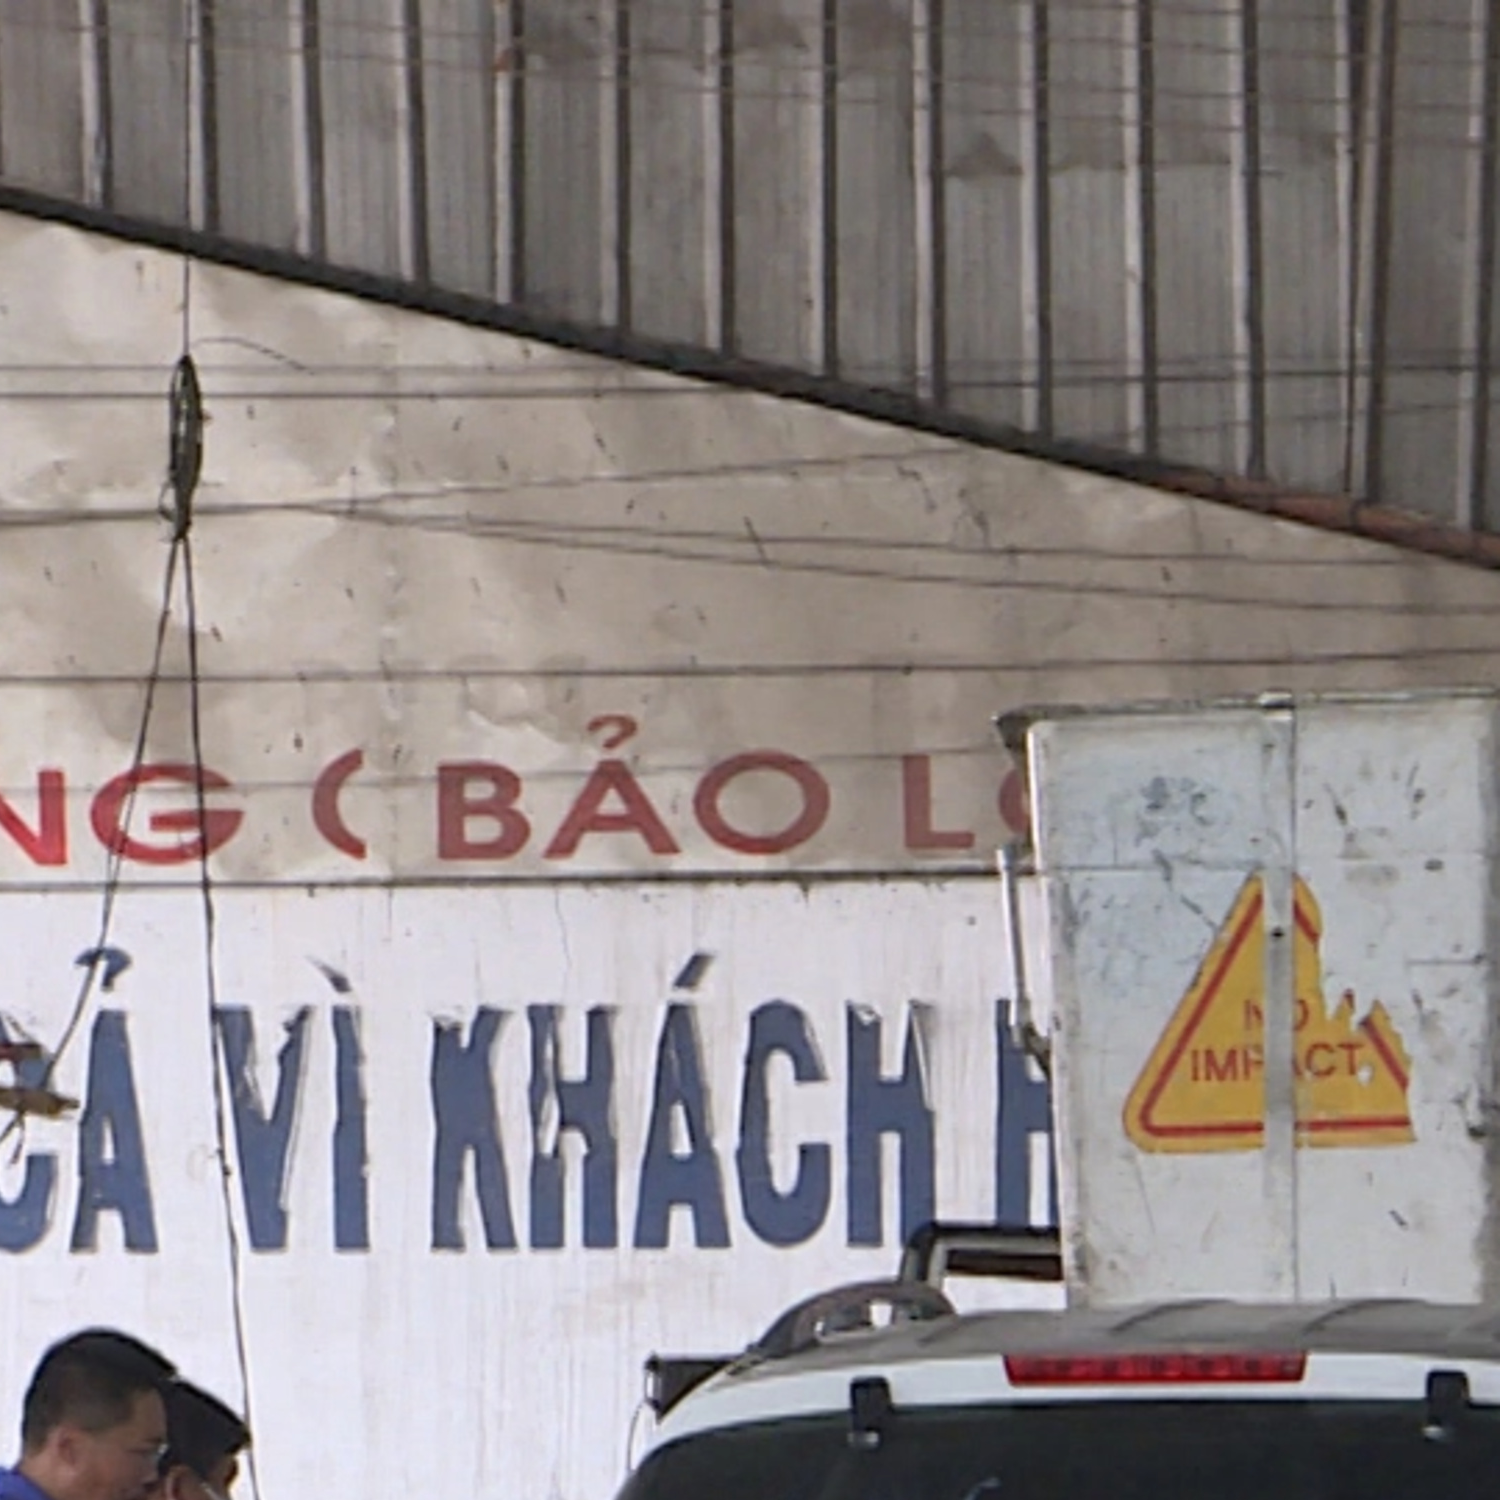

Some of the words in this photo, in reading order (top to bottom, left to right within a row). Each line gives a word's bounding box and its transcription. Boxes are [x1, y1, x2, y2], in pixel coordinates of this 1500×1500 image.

[436, 715, 831, 862] BẢO
[214, 957, 371, 1251] VÌ
[430, 952, 934, 1251] KHÁCH
[1190, 1041, 1366, 1083] IMPCT
